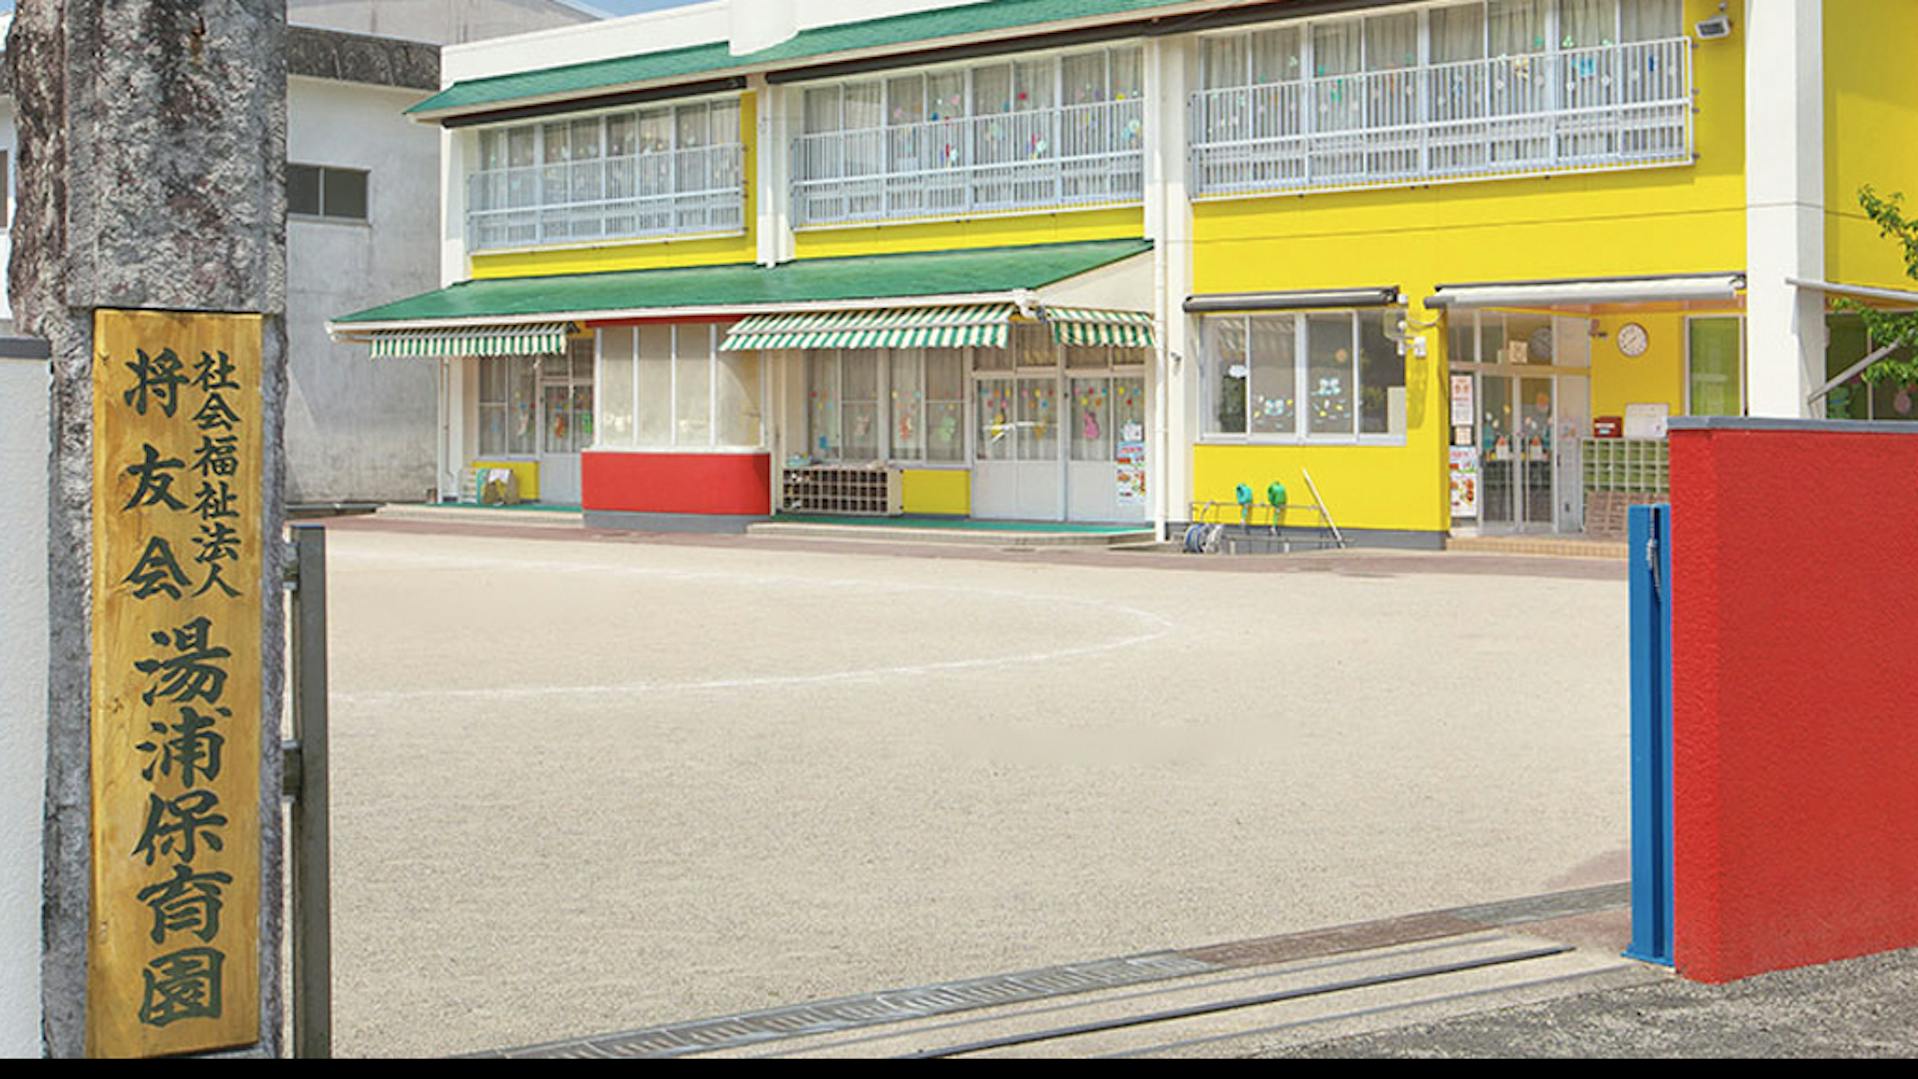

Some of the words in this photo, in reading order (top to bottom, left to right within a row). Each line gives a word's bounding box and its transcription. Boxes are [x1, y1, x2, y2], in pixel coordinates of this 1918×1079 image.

[123, 347, 192, 601] 将友会
[190, 350, 243, 598] 社会福祉法人
[131, 616, 234, 1029] 湯浦保育園
